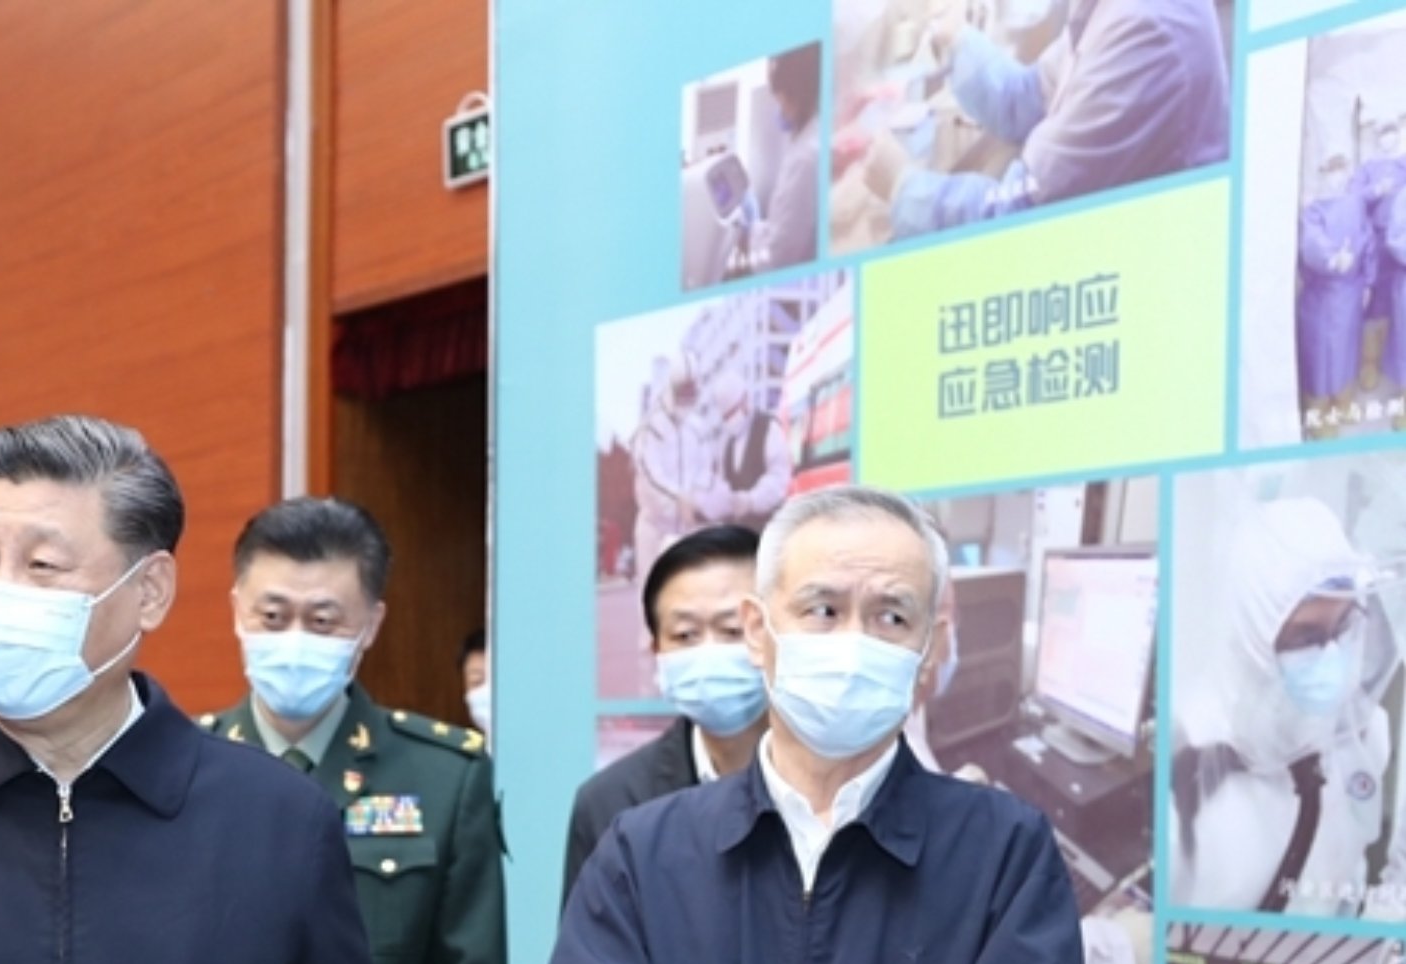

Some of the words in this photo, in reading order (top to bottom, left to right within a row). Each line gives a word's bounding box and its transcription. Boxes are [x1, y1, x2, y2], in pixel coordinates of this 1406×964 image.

[938, 272, 1120, 355] 迅即响应
[938, 338, 1120, 420] 应急检测
